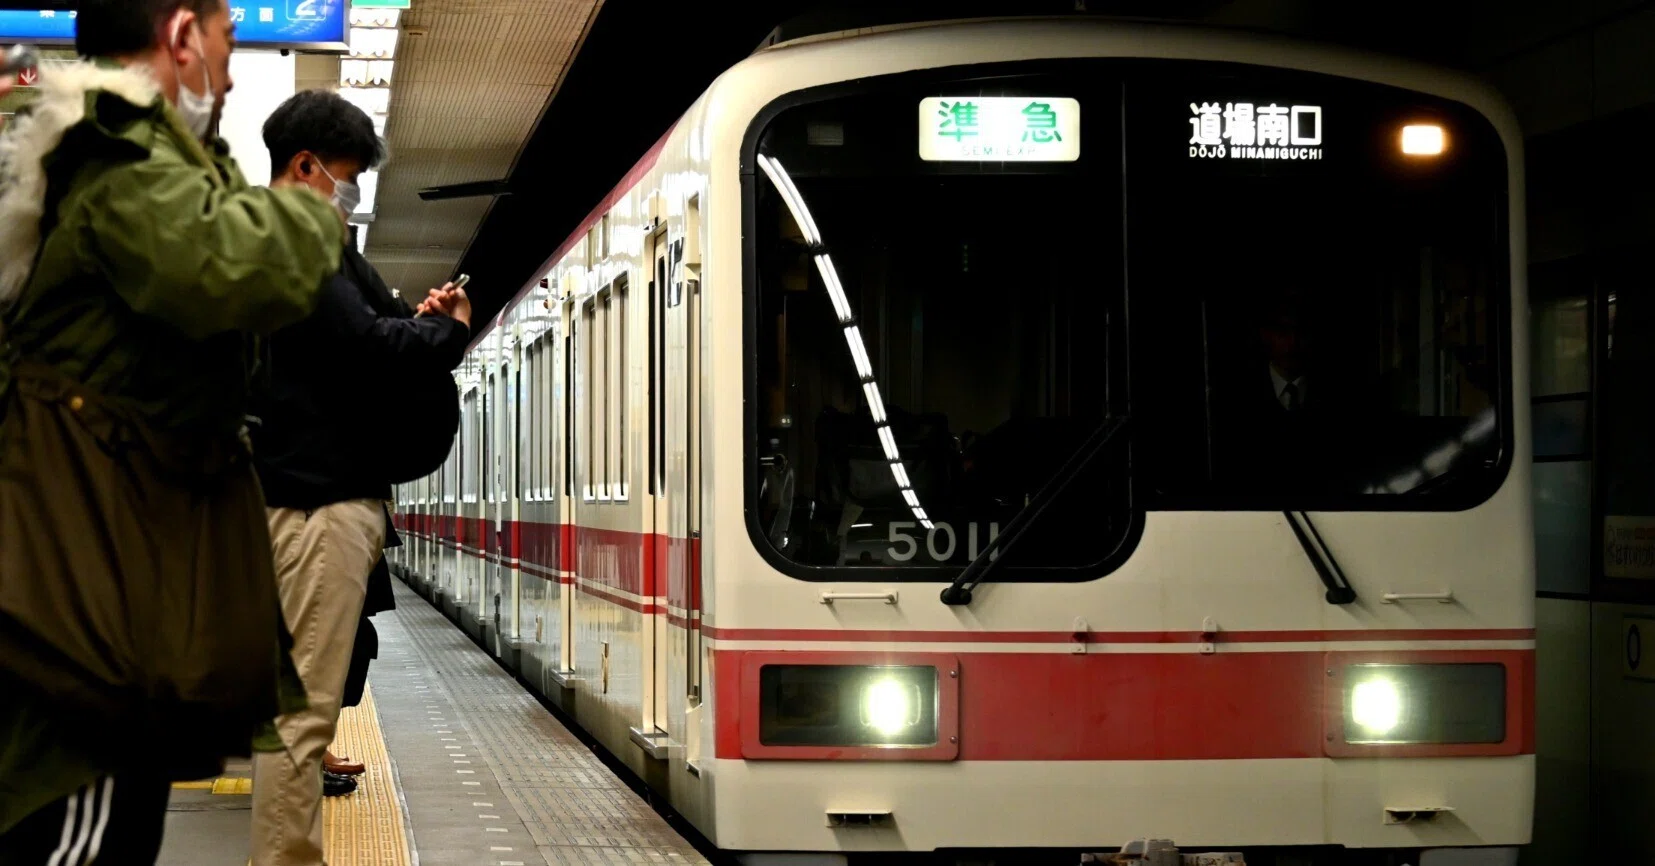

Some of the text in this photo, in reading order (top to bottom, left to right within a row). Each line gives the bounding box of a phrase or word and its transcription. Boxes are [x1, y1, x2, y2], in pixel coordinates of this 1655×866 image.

[938, 101, 1062, 142] 準急
[1189, 102, 1322, 146] 道場南口
[1231, 147, 1322, 160] MINAMIGUCHI
[887, 521, 999, 562] 5011
